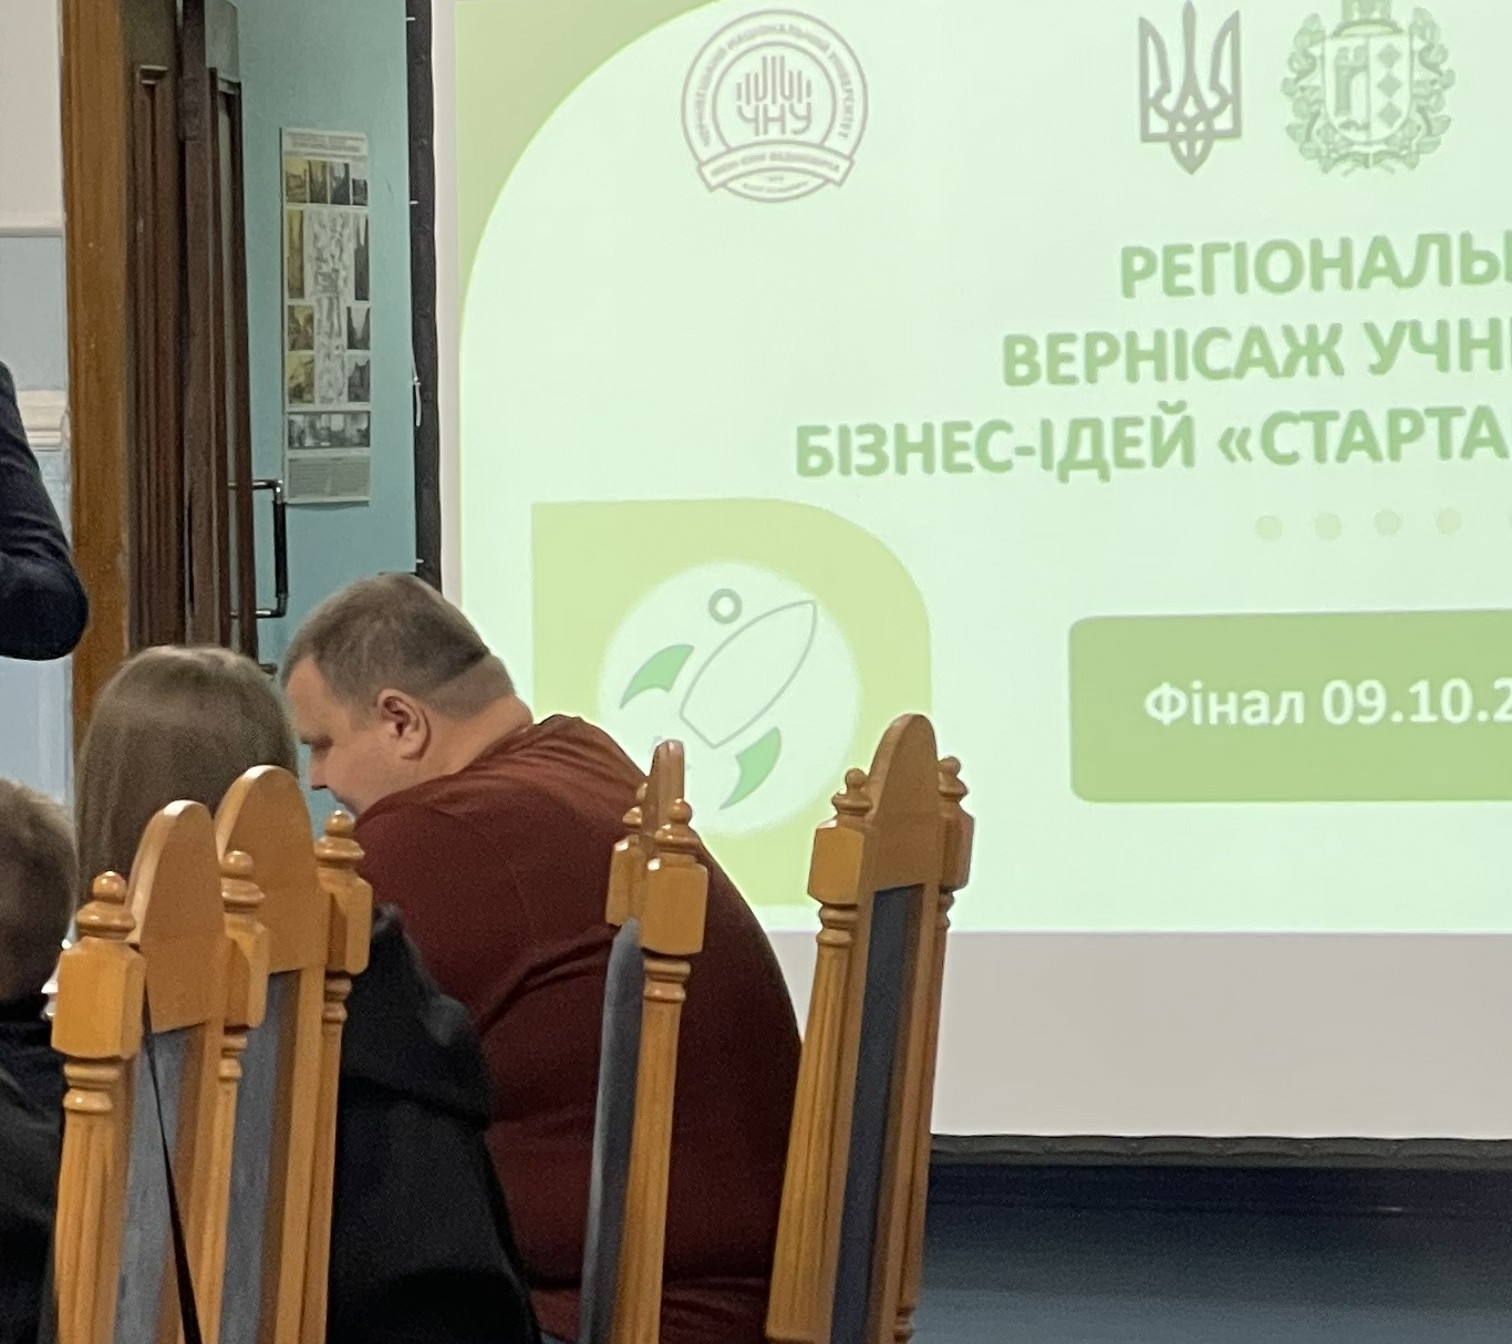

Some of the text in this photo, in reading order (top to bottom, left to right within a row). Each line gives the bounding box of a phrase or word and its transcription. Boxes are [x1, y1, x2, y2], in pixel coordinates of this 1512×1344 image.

[736, 102, 812, 137] ЧНУ
[1121, 229, 1512, 299] РЕГІОНАЛЬ
[1003, 316, 1512, 387] ВЕРНІСАЖ УЧН
[796, 400, 1510, 484] БІЗНЕС-ІДЕЙ «СТАРТА
[1144, 676, 1512, 726] Фінал 09.10.2
